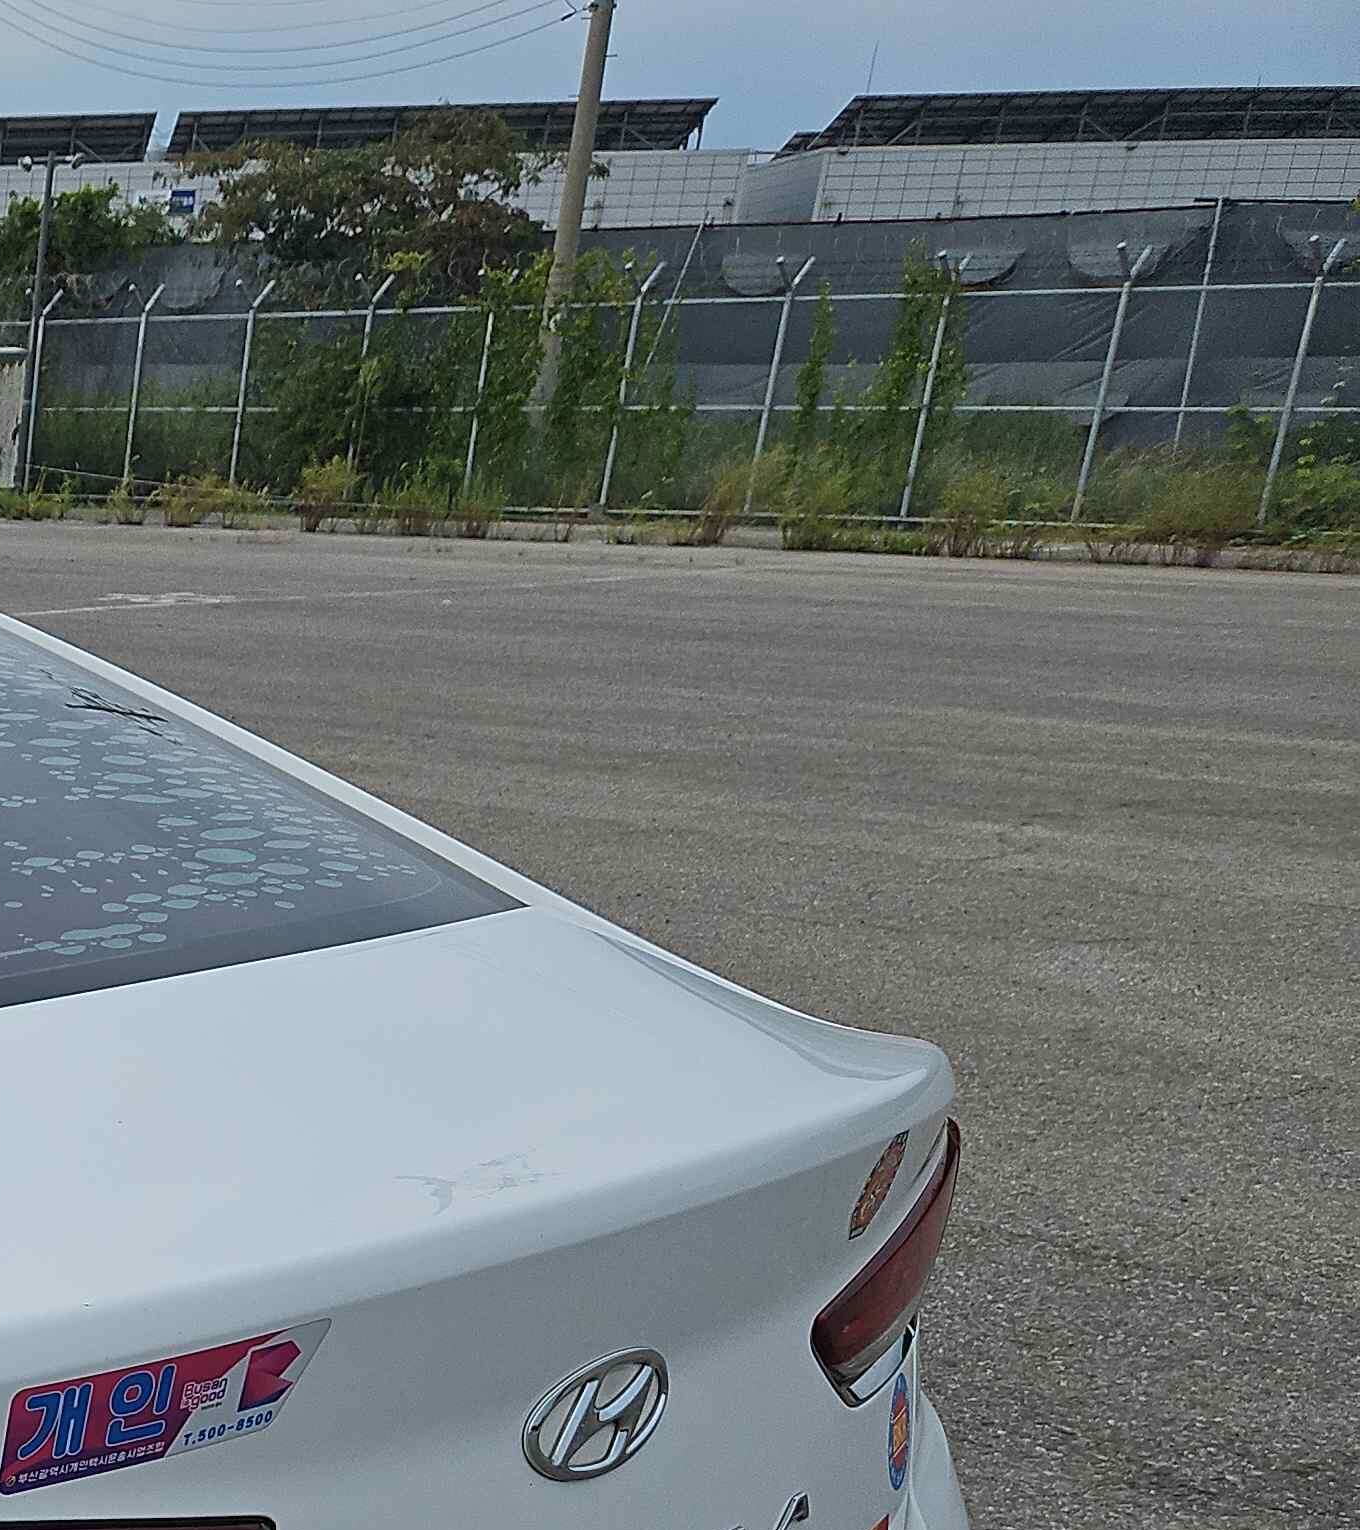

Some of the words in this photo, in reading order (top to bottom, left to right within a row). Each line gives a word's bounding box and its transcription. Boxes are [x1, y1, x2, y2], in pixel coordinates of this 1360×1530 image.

[184, 1377, 228, 1398] Busan
[189, 1388, 226, 1410] good
[18, 1363, 176, 1460] 개인
[183, 1410, 273, 1447] T.500-8500
